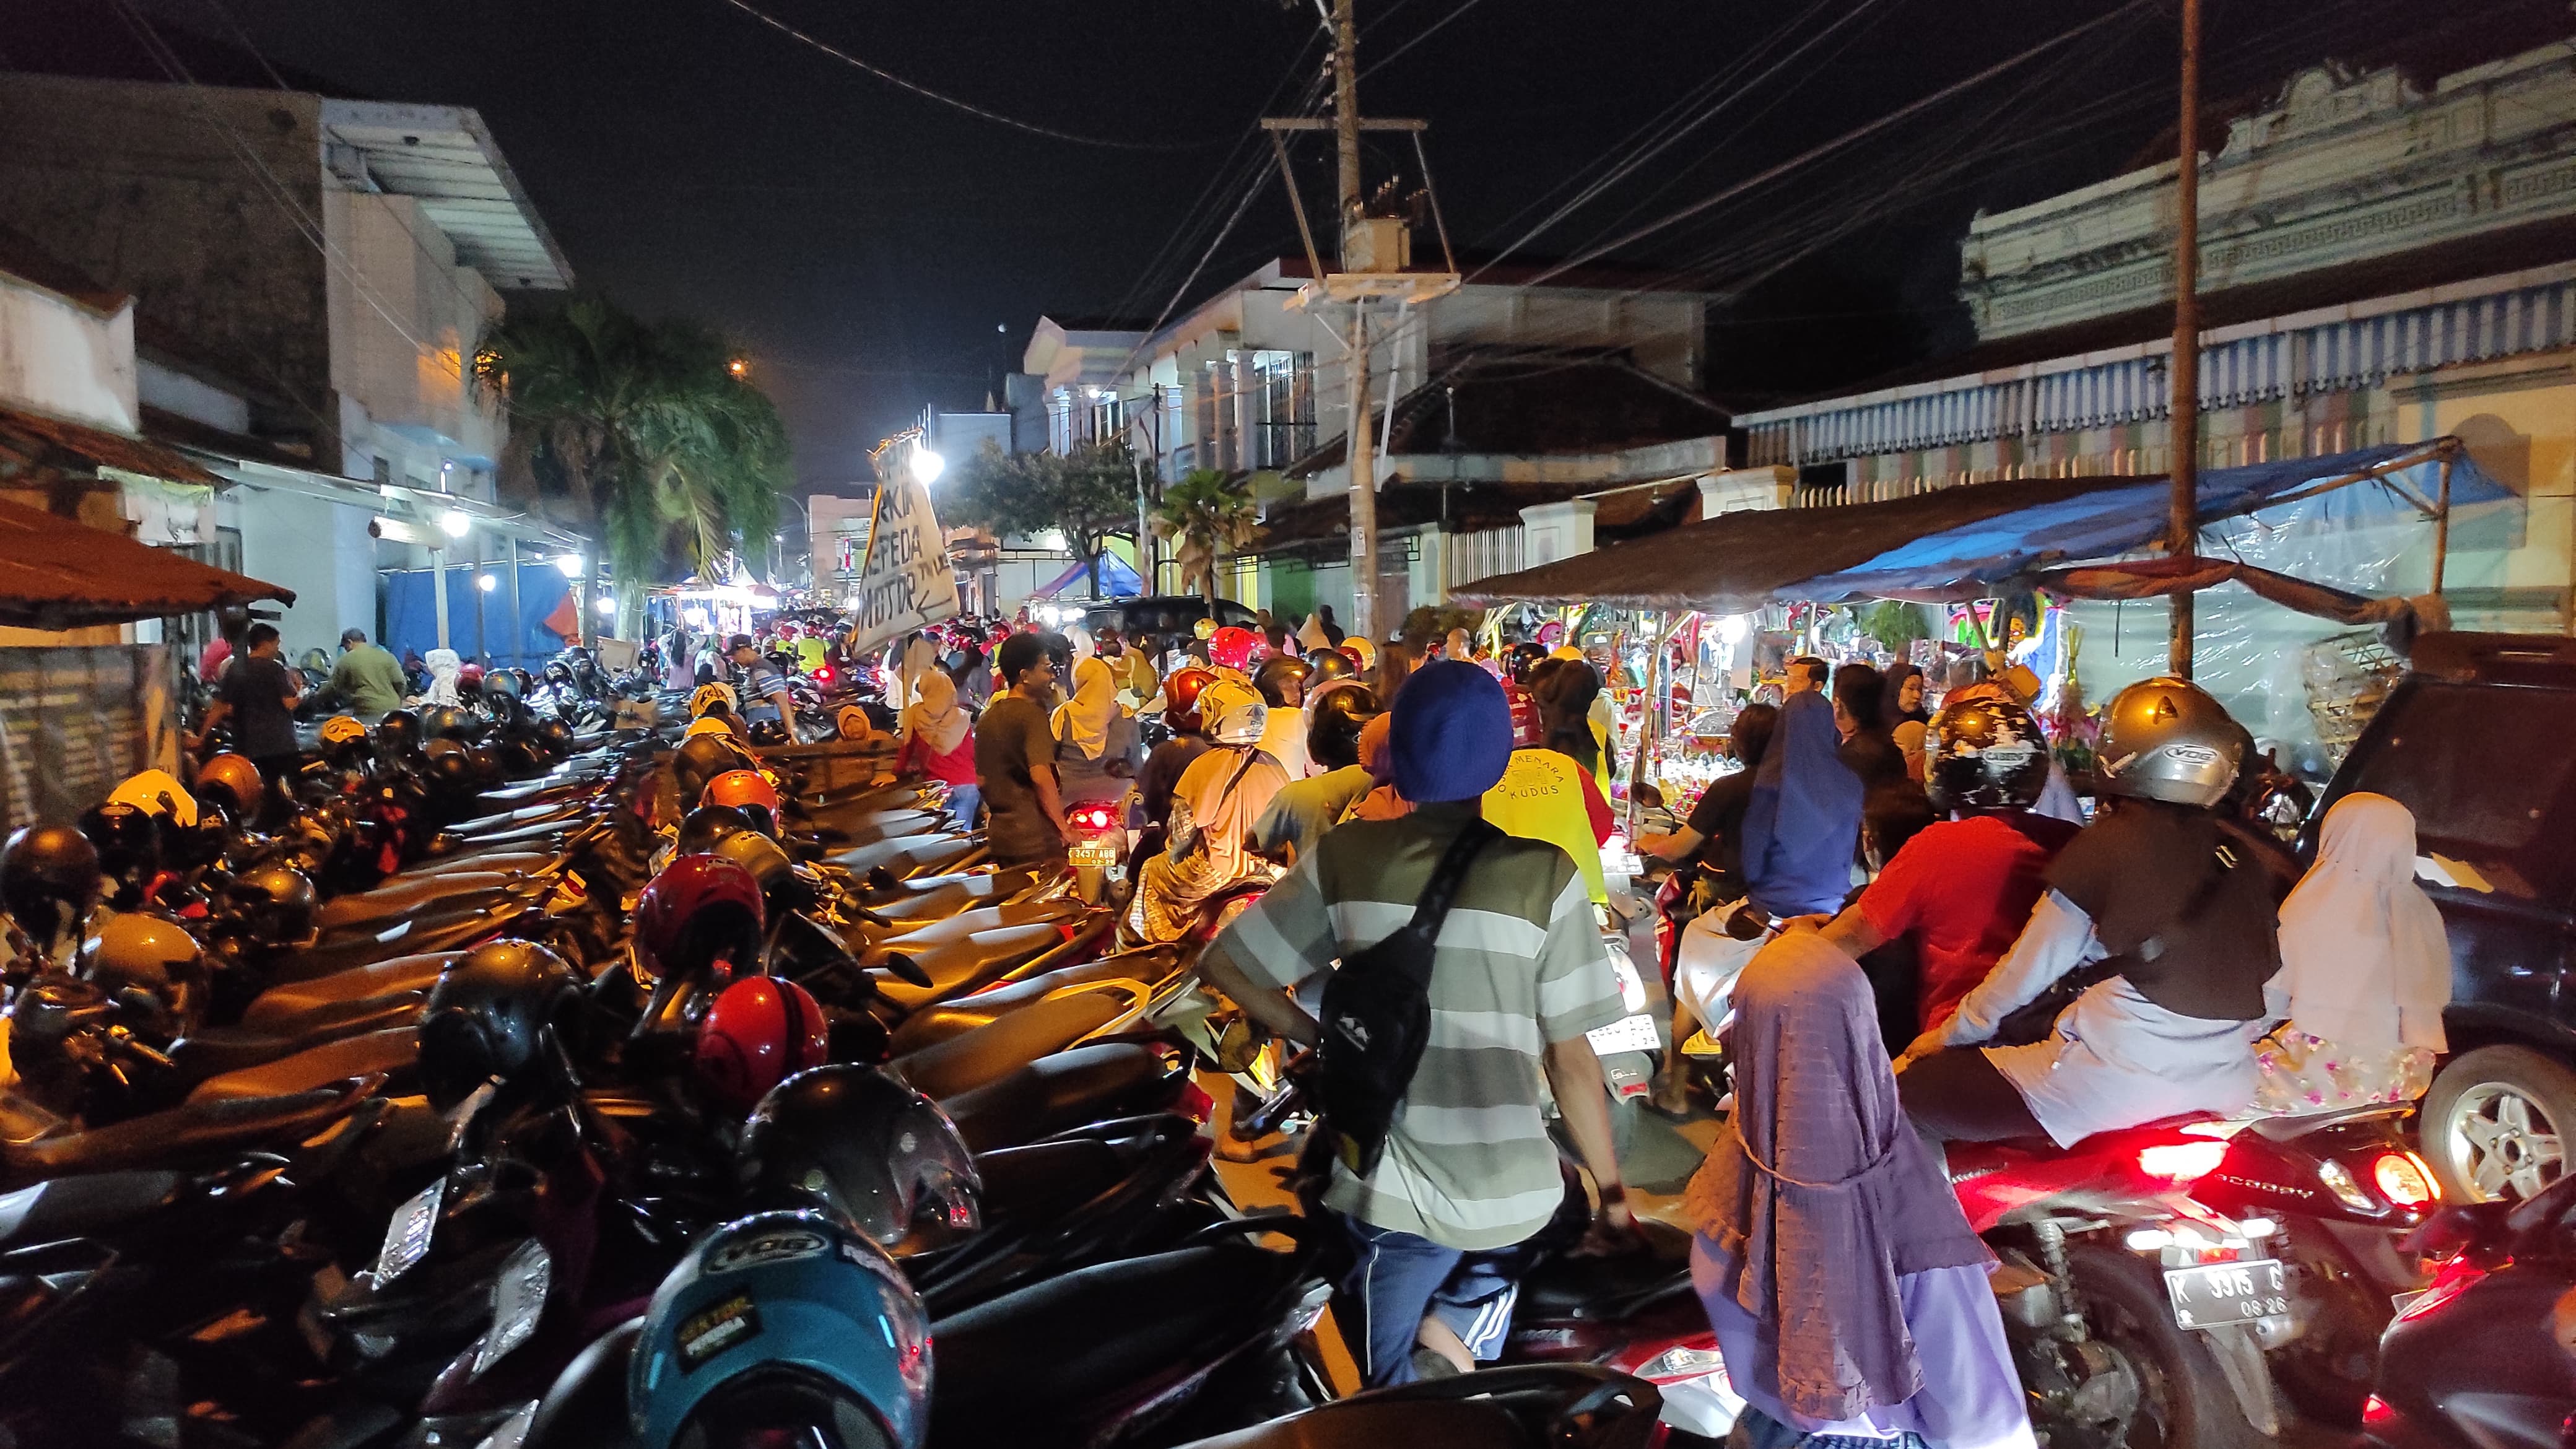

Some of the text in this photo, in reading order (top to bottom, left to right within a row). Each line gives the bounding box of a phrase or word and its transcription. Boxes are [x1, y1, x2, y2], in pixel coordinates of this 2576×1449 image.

[1515, 755, 1564, 783] MENARA
[1511, 785, 1559, 800] KUDUS
[1075, 849, 1095, 858] 3457
[2171, 1276, 2191, 1304] K
